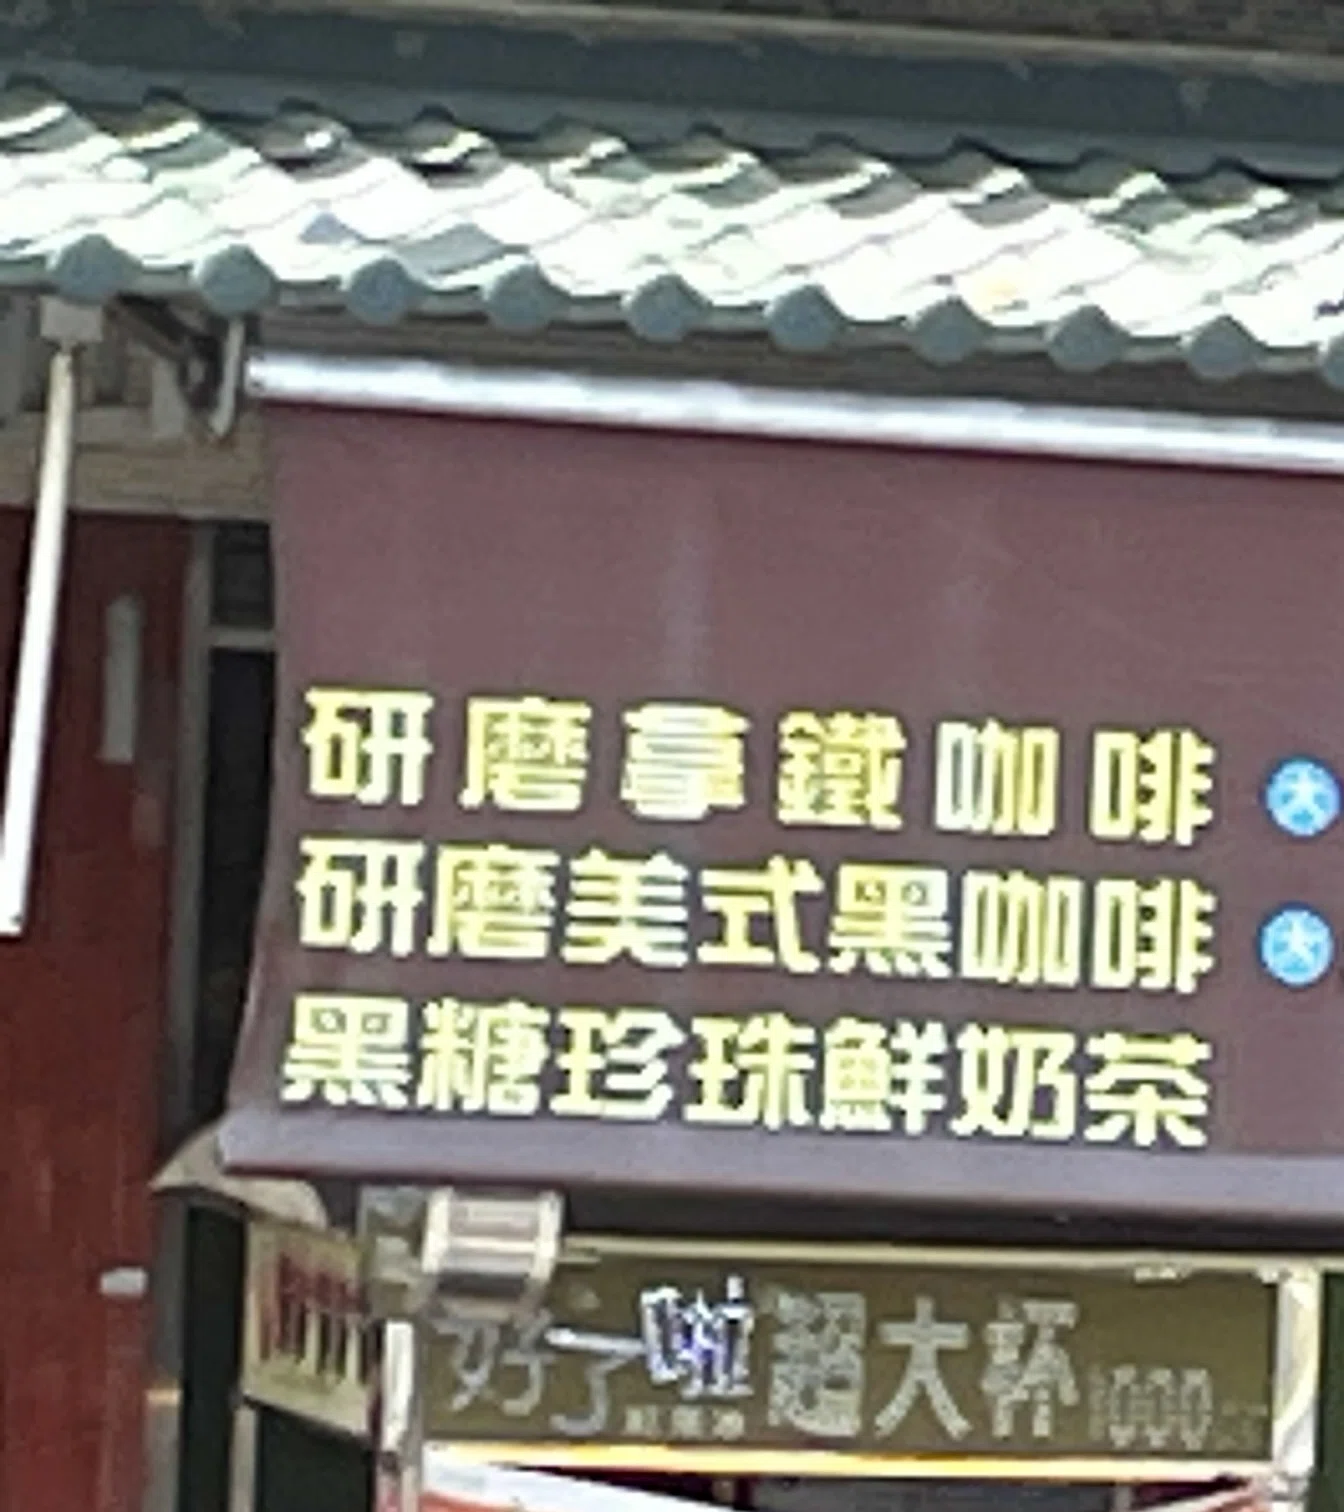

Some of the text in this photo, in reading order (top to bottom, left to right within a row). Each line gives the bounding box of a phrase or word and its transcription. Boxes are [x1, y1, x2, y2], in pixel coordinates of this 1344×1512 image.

[303, 686, 1216, 847] 研磨拿鐵咖啡
[295, 838, 1216, 995] 研磨美式黑咖啡
[280, 991, 1209, 1148] 黑糖珍珠鮮奶茶
